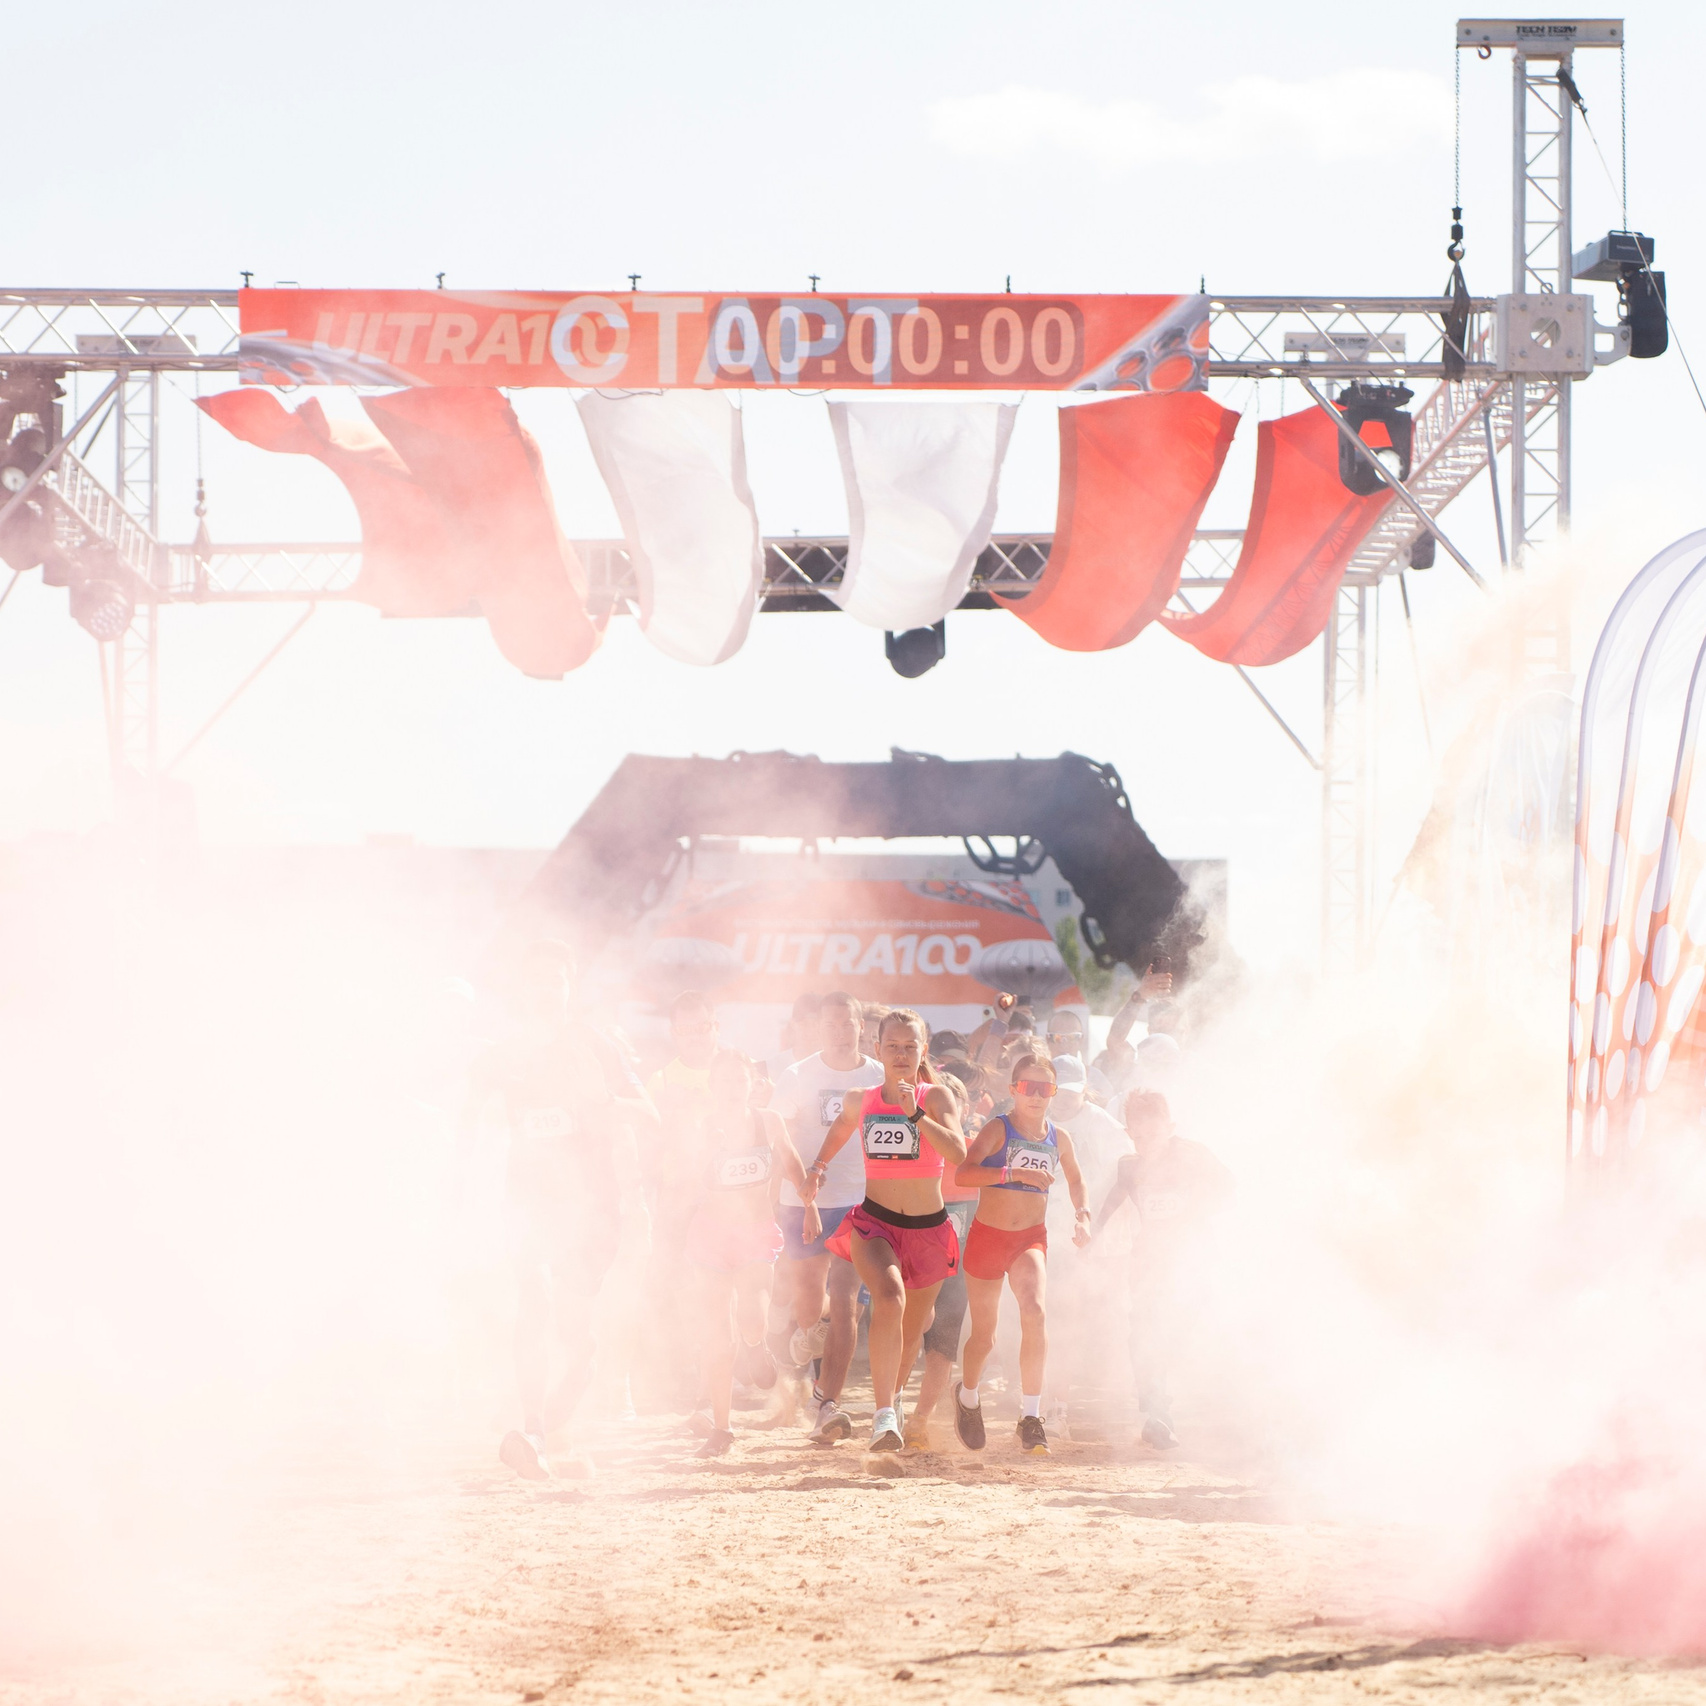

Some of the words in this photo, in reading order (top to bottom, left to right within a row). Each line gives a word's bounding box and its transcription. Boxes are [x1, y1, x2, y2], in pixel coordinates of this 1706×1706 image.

[714, 305, 1076, 376] 00:00:00
[734, 932, 981, 976] ULTRA100
[874, 1130, 904, 1145] 229
[729, 1162, 758, 1177] 239
[1020, 1156, 1048, 1170] 256
